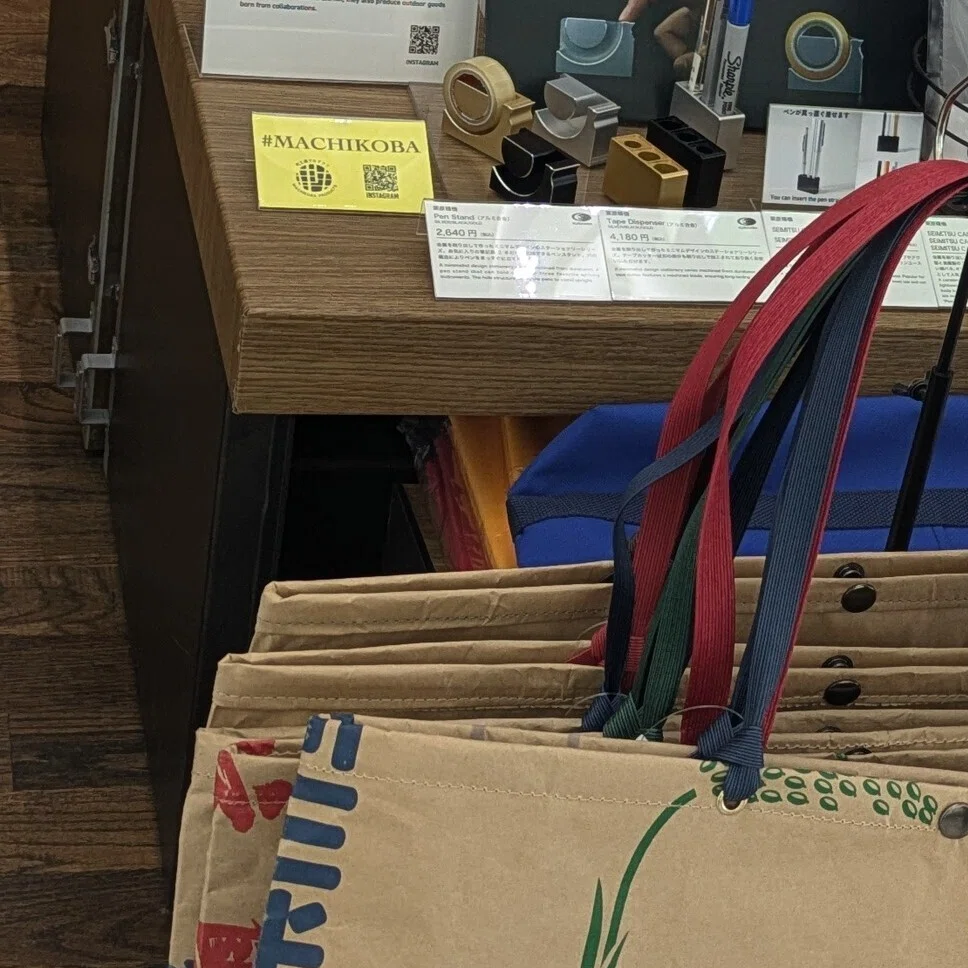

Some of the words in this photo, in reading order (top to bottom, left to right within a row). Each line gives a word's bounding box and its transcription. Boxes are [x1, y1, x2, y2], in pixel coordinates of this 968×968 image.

[272, 3, 317, 11] collaborations.
[262, 134, 421, 154] #MACHIKOBA
[607, 218, 625, 226] Tape
[628, 218, 665, 226] Dispenser
[436, 228, 466, 237] 2,640
[468, 229, 477, 238] 円
[610, 233, 638, 241] 4,180
[640, 233, 650, 242] 円
